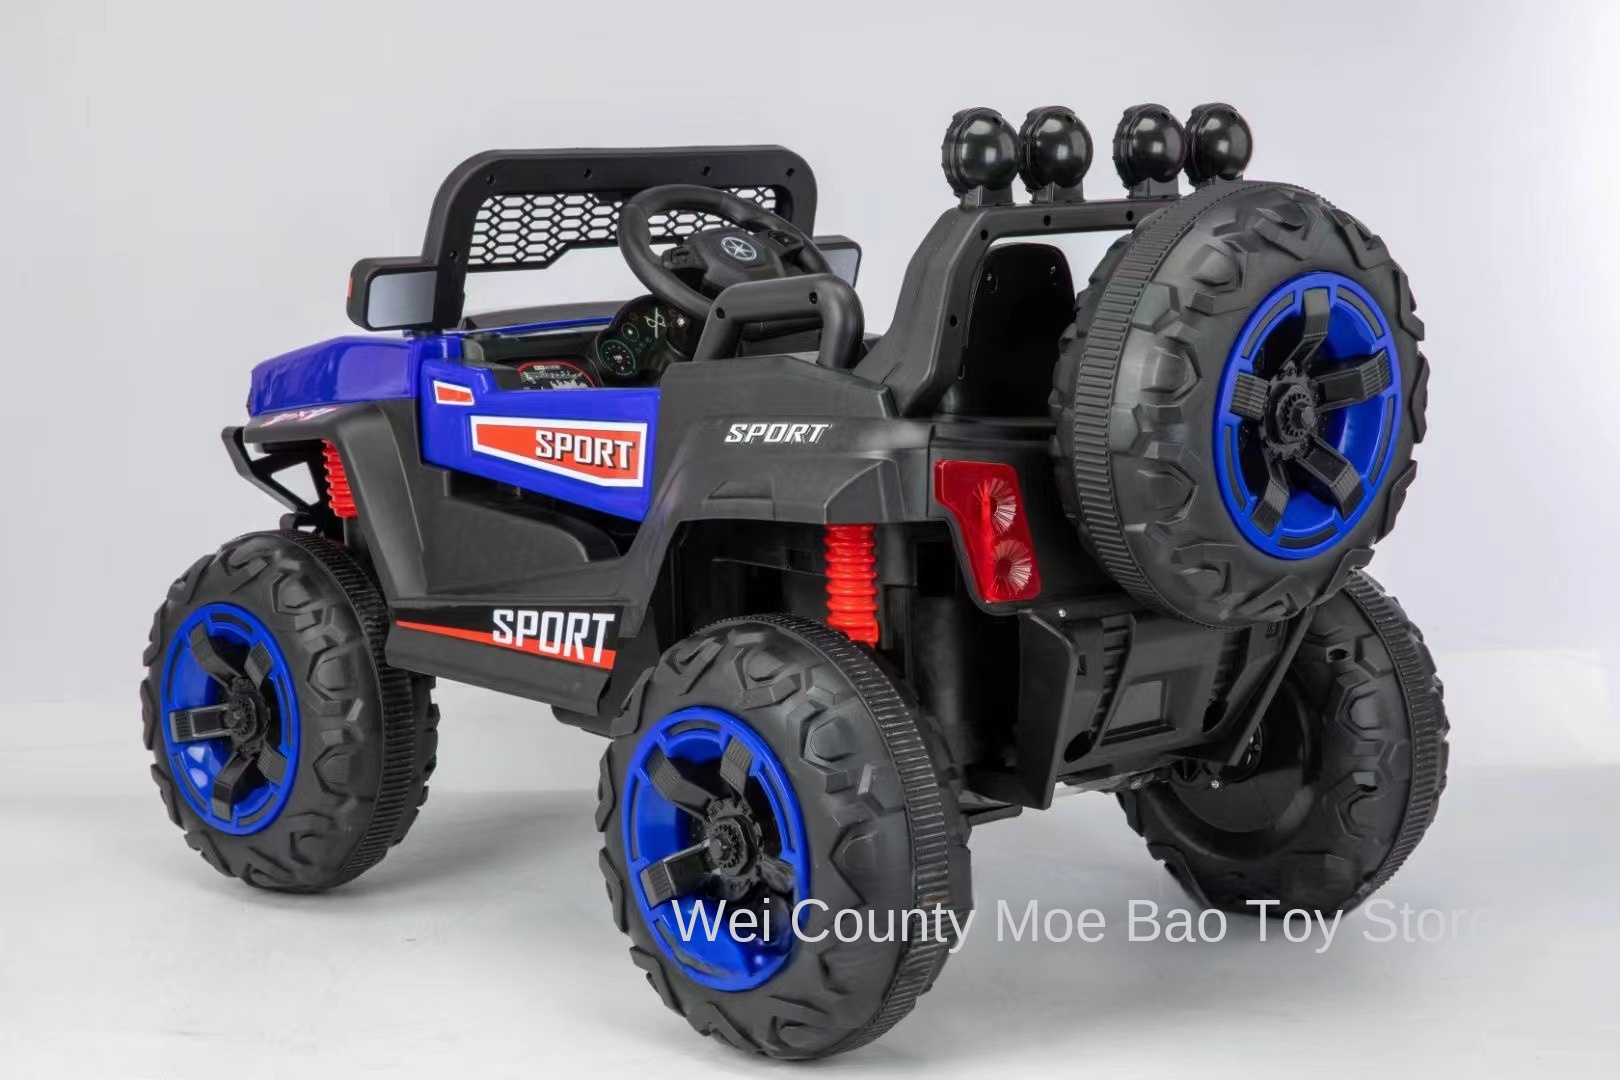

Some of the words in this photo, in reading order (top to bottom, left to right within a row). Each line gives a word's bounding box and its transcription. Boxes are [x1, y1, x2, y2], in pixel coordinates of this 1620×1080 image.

[535, 429, 634, 470] SPORT
[725, 423, 832, 443] SPORT
[492, 609, 616, 663] SPORT
